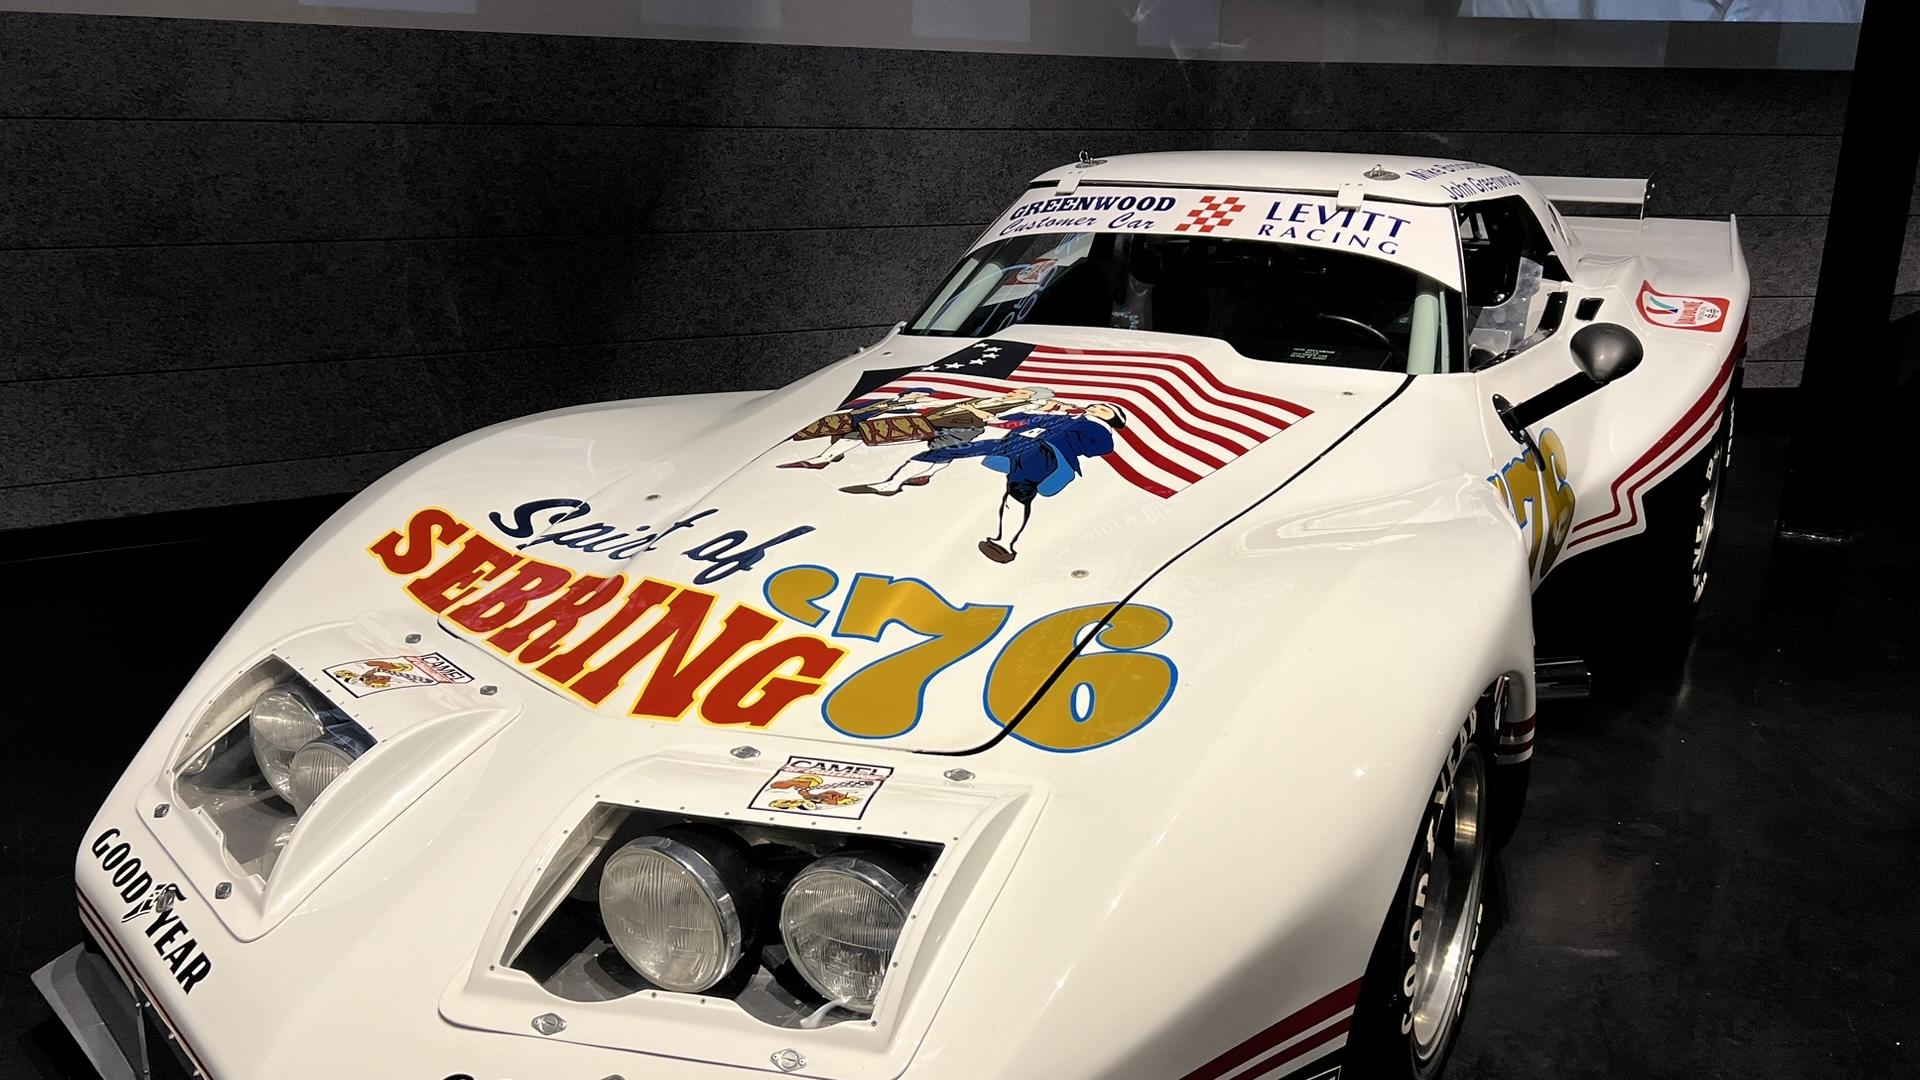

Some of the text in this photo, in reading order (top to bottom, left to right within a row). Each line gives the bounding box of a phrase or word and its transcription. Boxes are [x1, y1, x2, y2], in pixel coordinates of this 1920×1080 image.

[1440, 181, 1478, 200] John
[1009, 195, 1177, 221] GREENWOOD
[1265, 201, 1412, 238] LEVITT
[999, 211, 1155, 237] Customer Car
[1257, 223, 1399, 255] RACING
[681, 525, 817, 585] of
[366, 504, 849, 730] SEBRING
[421, 655, 466, 682] CAMEL
[790, 759, 880, 777] CAMEL
